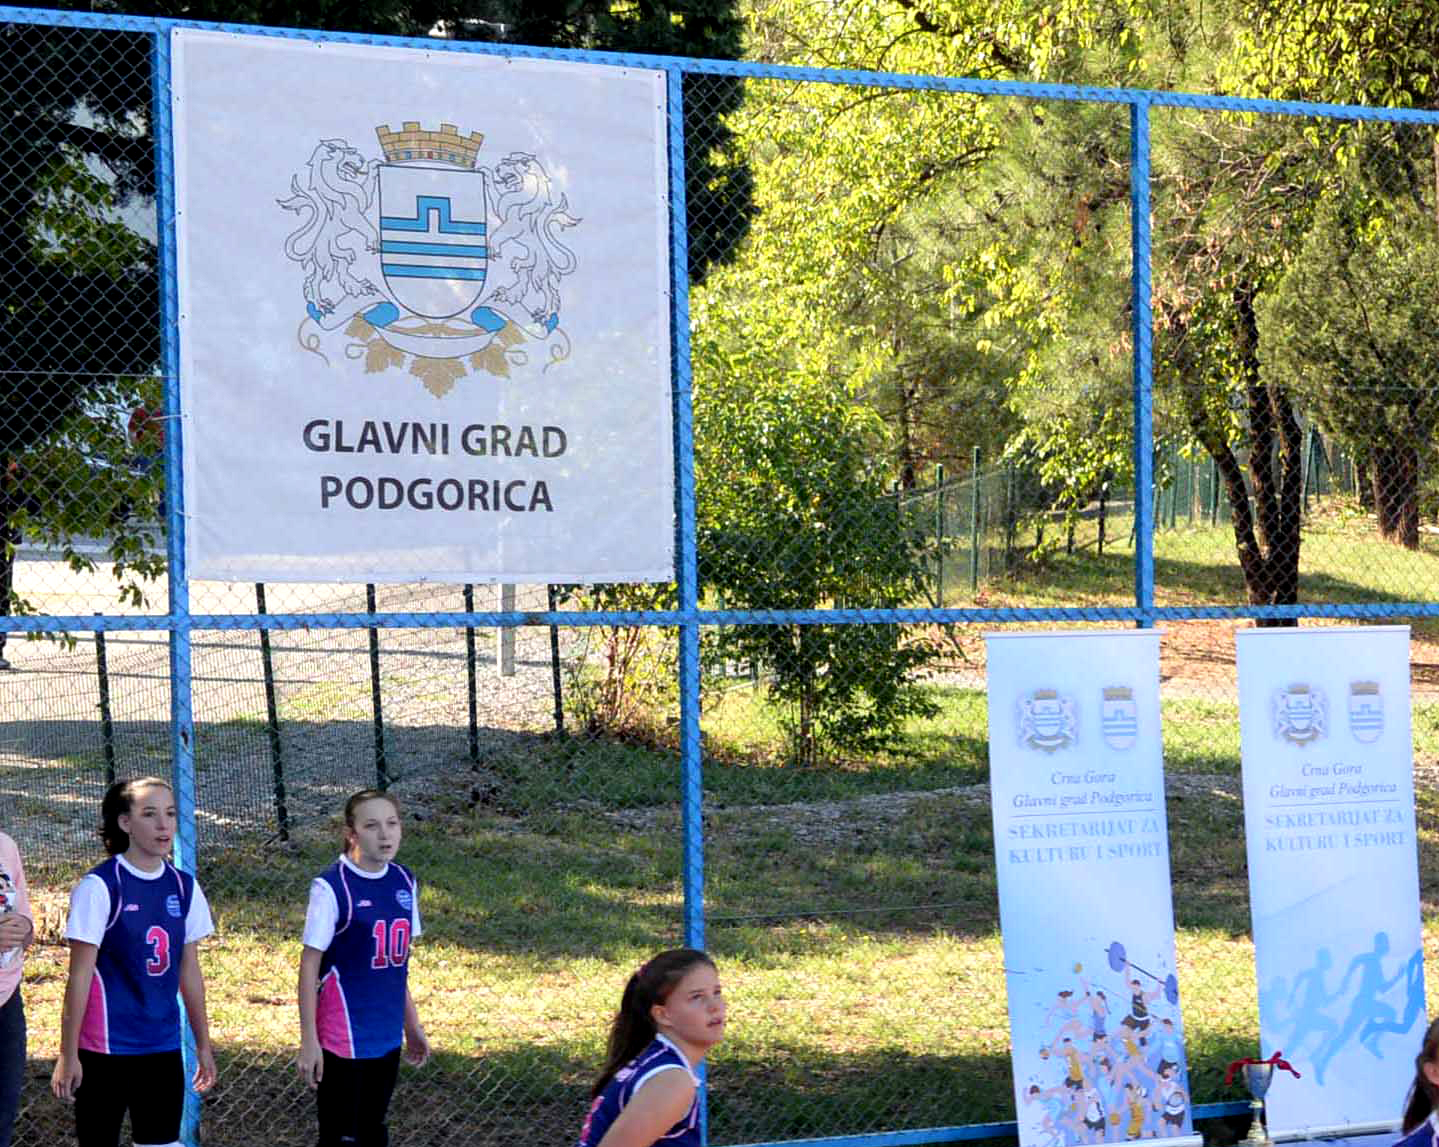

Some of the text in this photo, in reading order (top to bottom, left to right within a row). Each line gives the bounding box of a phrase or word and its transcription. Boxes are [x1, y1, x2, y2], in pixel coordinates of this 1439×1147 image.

[302, 419, 567, 458] GLAVNI GRAD
[319, 475, 554, 512] PODGORICA
[146, 925, 171, 977] 3
[371, 918, 411, 970] 10
